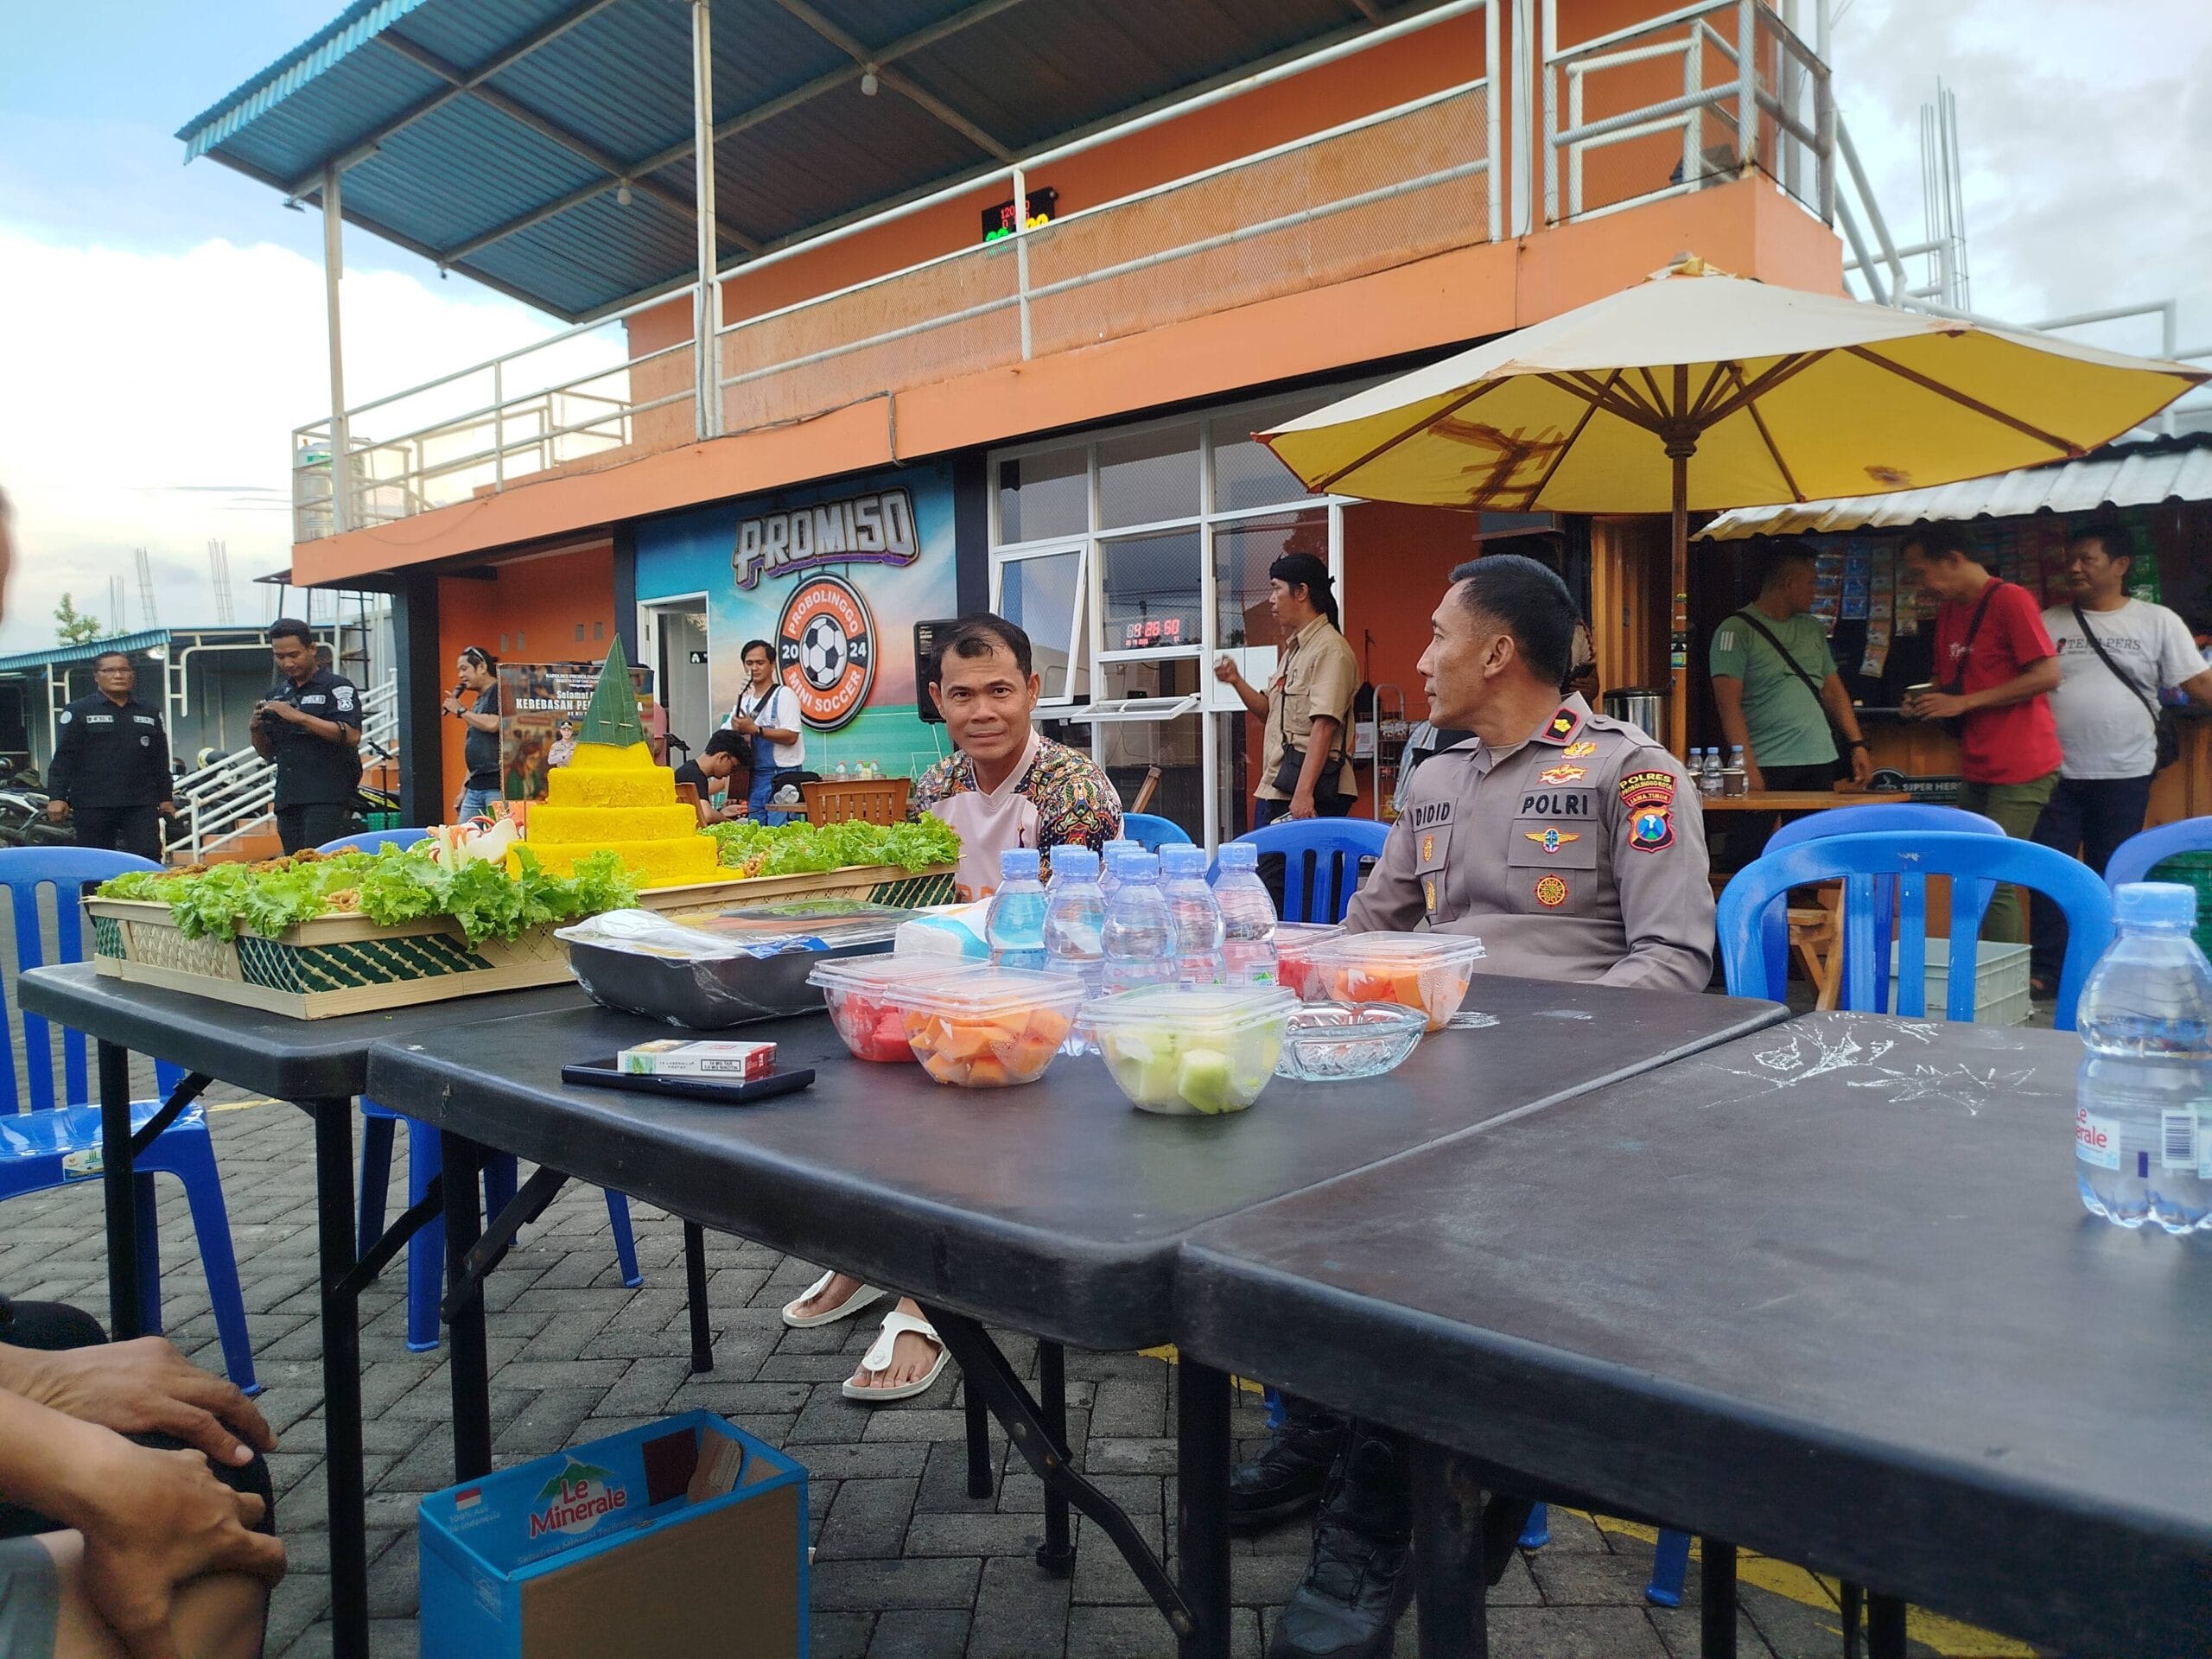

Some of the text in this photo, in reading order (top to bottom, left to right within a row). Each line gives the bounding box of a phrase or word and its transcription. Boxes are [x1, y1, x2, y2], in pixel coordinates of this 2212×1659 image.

[733, 489, 918, 588] PROMISO
[788, 589, 859, 635] PROBOLINGGO
[781, 642, 868, 659] 20 24
[556, 690, 589, 700] Selamat
[788, 670, 861, 713] MINI SOCCER
[516, 698, 573, 710] KEBEBASAN
[1619, 772, 1672, 789] POLRES
[1521, 793, 1588, 816] POLRI
[1649, 792, 1669, 802] TIMUR
[560, 1478, 589, 1505] Le
[529, 1487, 627, 1540] Minerale
